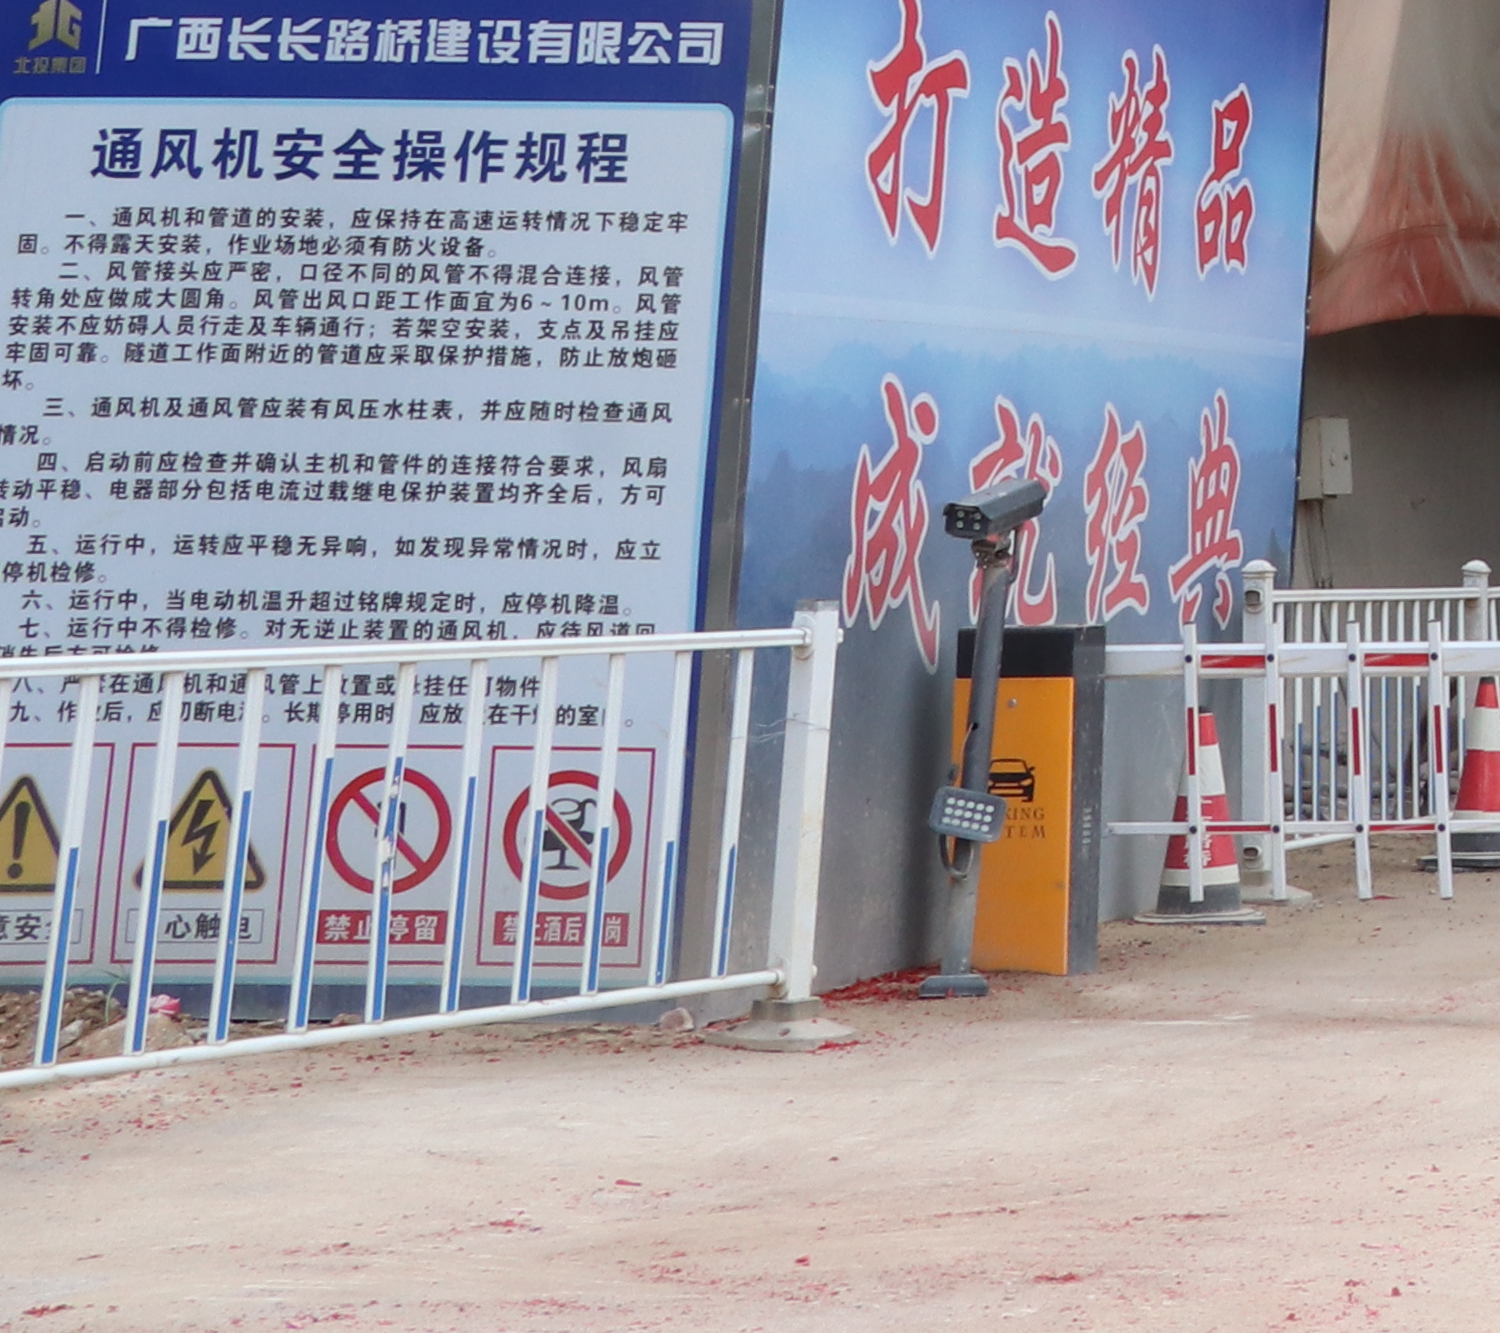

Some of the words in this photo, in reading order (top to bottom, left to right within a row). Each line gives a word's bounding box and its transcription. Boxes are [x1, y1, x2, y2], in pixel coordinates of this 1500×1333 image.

[124, 17, 725, 66] 广西长长路桥建设有限公司
[13, 56, 86, 75] 北投集团
[90, 127, 630, 185] 通风机安全操作规程
[64, 206, 689, 234] 一、通风机和管道的安装，应保持在高速运转情况下稳定牢
[17, 234, 497, 259] 固。不得露天安装，作业场地必须有防火设备。
[58, 261, 685, 288] 二、风管接头应严密，口径不同的风管不得混合连接，风管
[5, 342, 678, 369] 牢固可靠。隧道工作面附近的管道应采取保护措施，防止放炮砸
[1, 369, 35, 391] 坏。
[42, 397, 673, 424] 三、通风机及通风管应装有风压水柱表，并应随时检查通风
[0, 424, 52, 446] 情况。
[37, 451, 668, 479] 四、启动前应检查并确认主机和管件的连接符合要求，风扇
[0, 506, 42, 528] 动。
[26, 534, 662, 561] 五、运行中，运转应平稳无异响，如发现异常情况时，应立
[21, 589, 633, 616] 六、运行中，当电动机温升超过铭牌规定时，应停机降温。
[324, 914, 439, 941] 禁止停留
